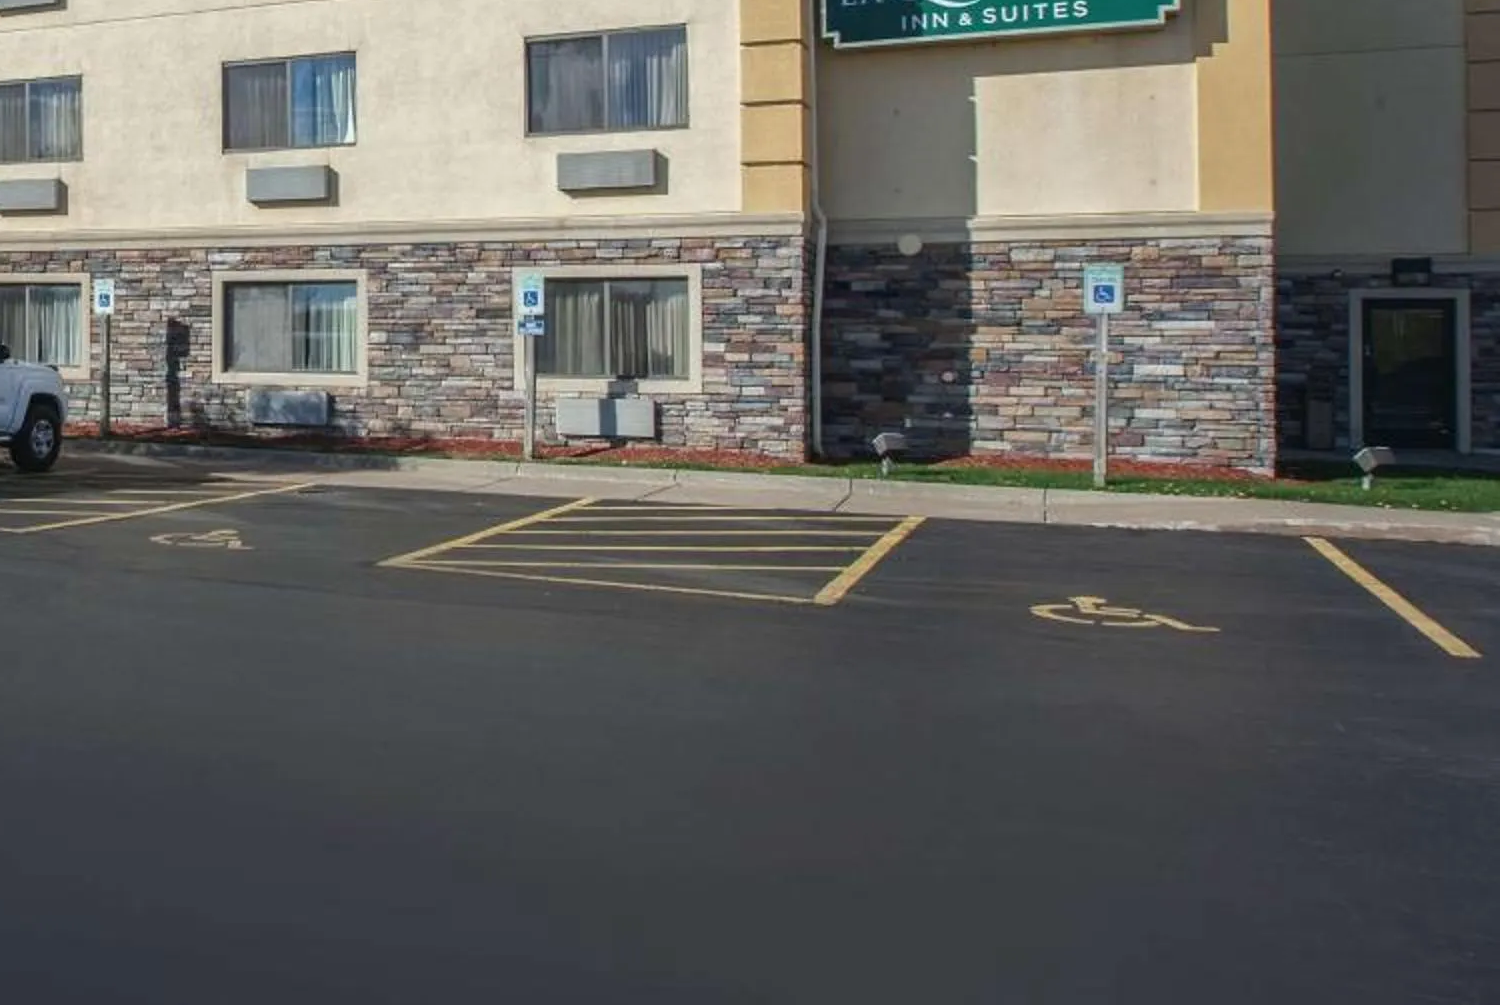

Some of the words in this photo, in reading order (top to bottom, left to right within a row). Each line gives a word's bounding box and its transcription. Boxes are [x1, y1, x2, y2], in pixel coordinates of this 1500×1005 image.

[901, 9, 949, 31] INN
[959, 7, 973, 26] &
[982, 0, 1089, 25] SUITES
